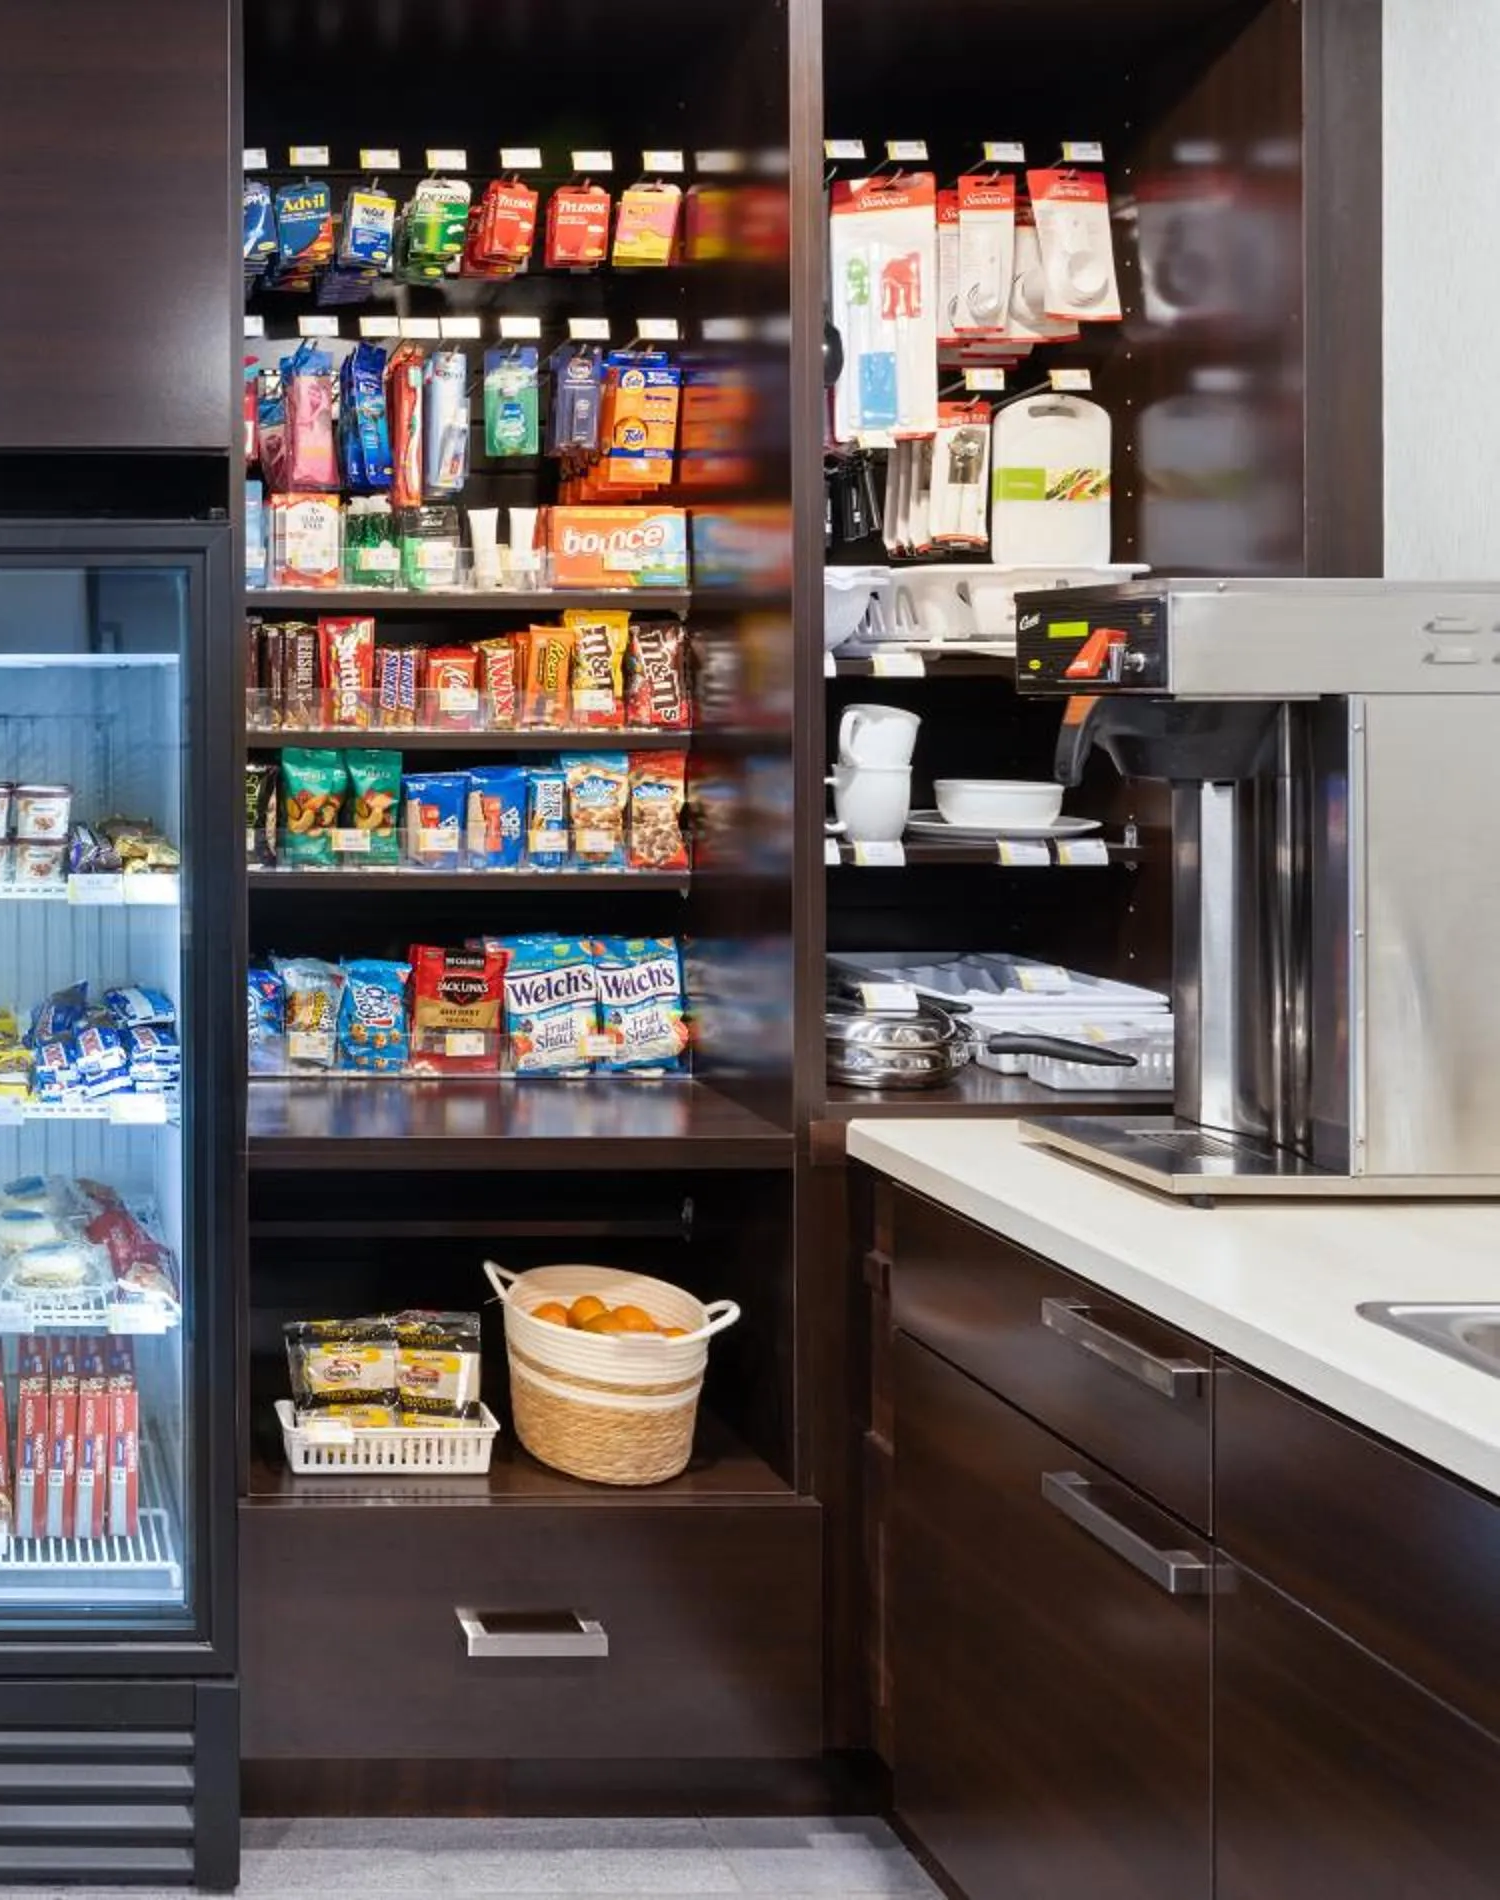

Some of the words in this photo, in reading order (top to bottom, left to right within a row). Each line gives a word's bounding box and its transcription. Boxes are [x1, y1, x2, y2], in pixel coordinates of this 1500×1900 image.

[284, 194, 325, 212] Advil
[557, 202, 605, 213] TYLENOL
[562, 523, 665, 557] bounce
[508, 969, 594, 1007] Welch's
[600, 964, 675, 1000] Welch's
[543, 1016, 575, 1034] Fruit
[632, 1011, 660, 1030] Fruit
[625, 1024, 670, 1046] Snacks
